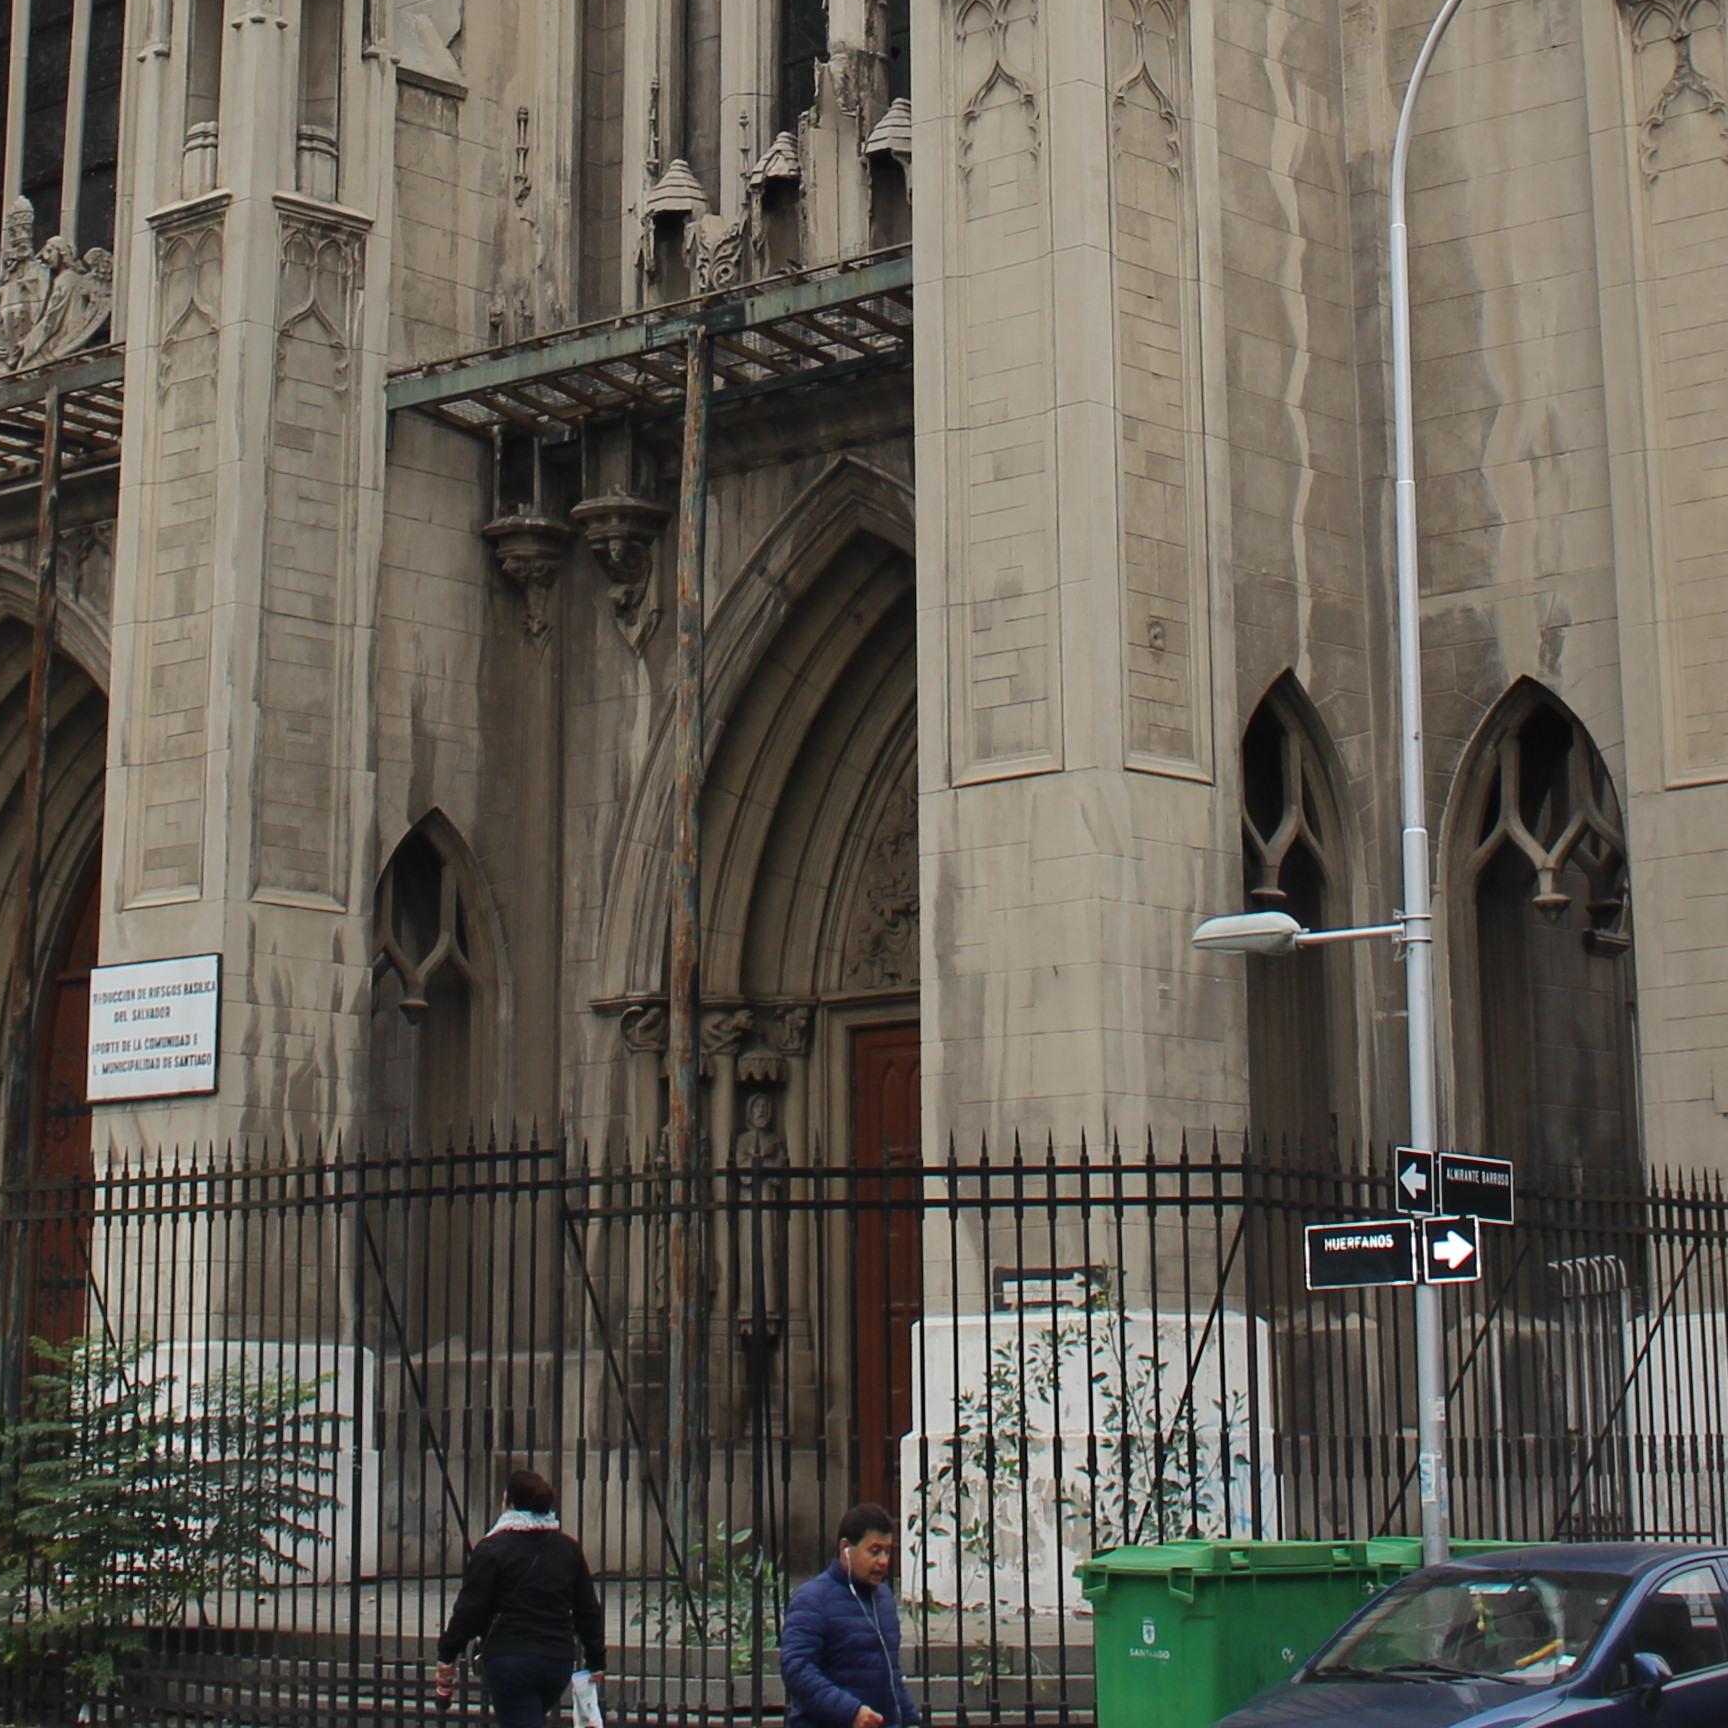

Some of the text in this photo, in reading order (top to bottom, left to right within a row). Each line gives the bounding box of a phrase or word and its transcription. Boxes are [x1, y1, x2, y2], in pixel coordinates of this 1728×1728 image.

[137, 988, 147, 1000] DE
[148, 984, 182, 999] RIESGOS
[183, 980, 215, 995] BASILICA
[113, 1006, 171, 1023] DEL SALVADOR
[92, 1033, 199, 1055] APORTE DE LA COMUNIDAD E
[102, 1058, 161, 1075] MUNICIPALIDAD
[162, 1057, 172, 1069] DE
[174, 1053, 213, 1068] SANTIAGO
[1446, 1167, 1509, 1187] ALMIRANTE BARROSO
[1324, 1234, 1394, 1252] HUERFANOS
